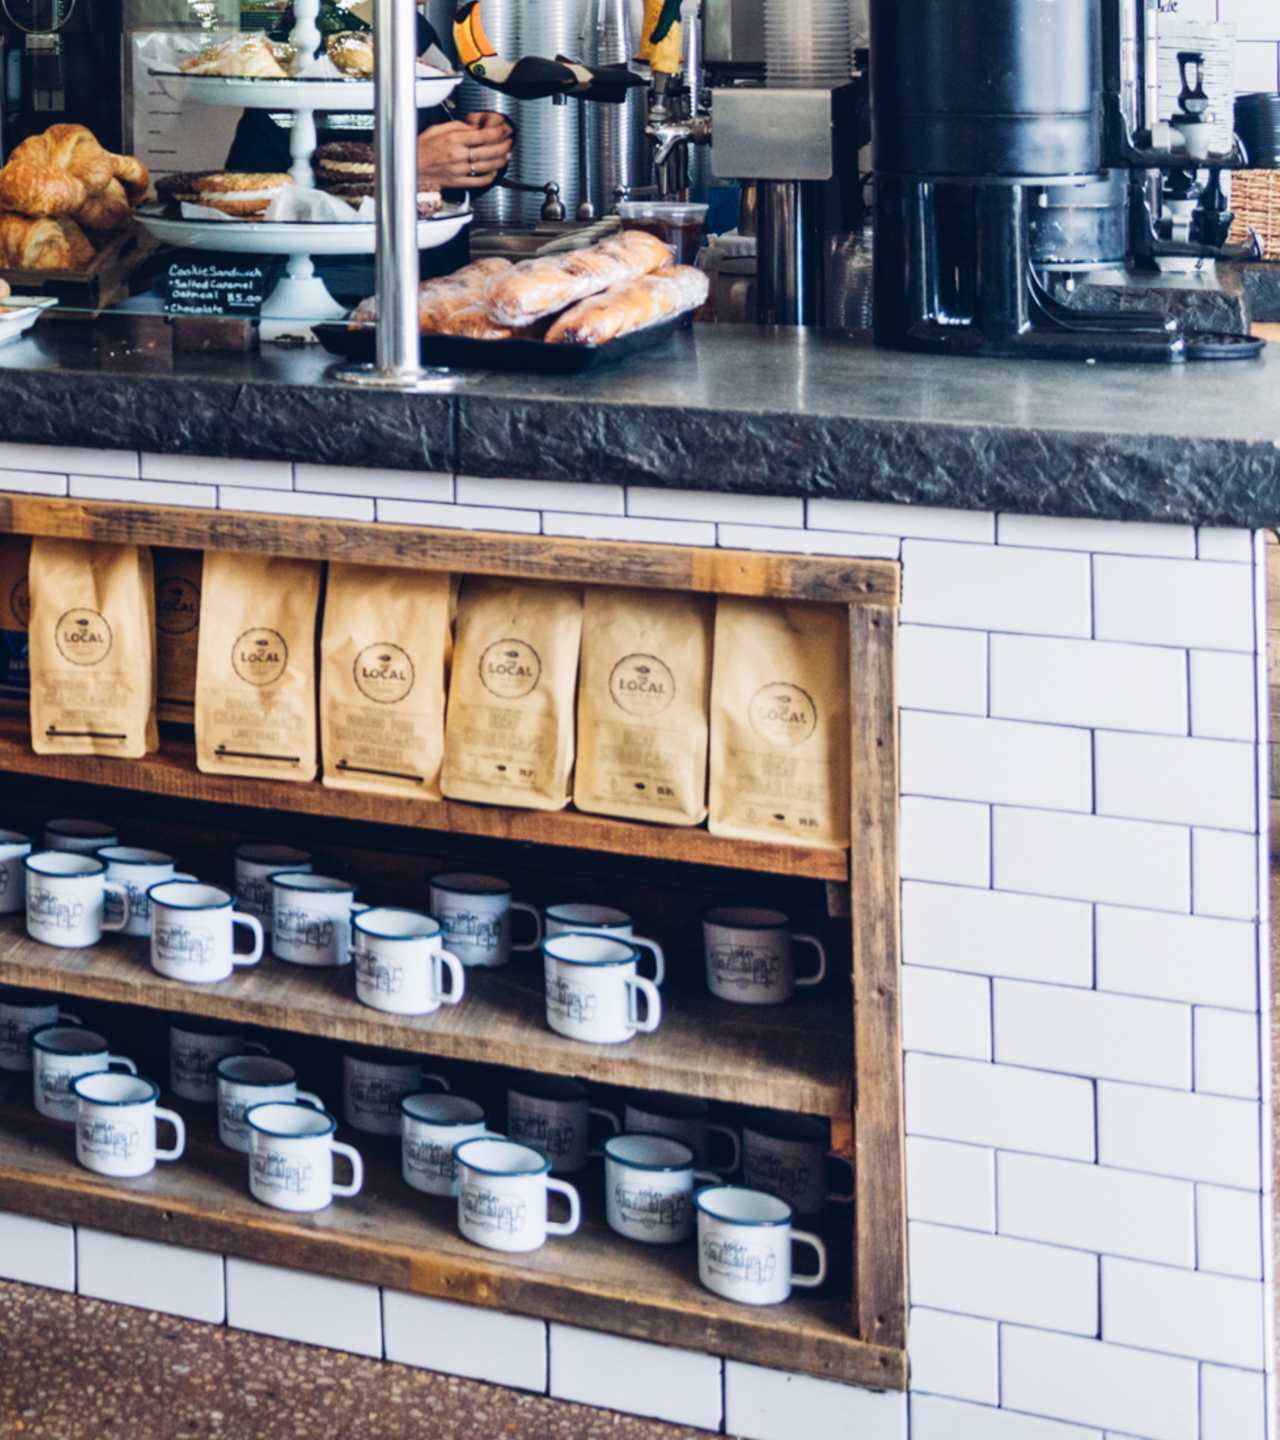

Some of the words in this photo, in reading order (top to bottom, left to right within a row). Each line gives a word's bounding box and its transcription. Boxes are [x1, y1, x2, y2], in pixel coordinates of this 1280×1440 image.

[169, 264, 207, 276] Cookie
[209, 265, 262, 278] Sandwich
[174, 279, 208, 289] Salted
[210, 280, 253, 289] Caramel
[172, 290, 218, 299] Oatmeal
[64, 632, 104, 643] LOCAL
[241, 651, 280, 663] LOCAL
[362, 667, 407, 681] LOCAL
[488, 663, 532, 677] LOCAL
[619, 678, 665, 694] LOCAL
[758, 706, 808, 724] LOCAL
